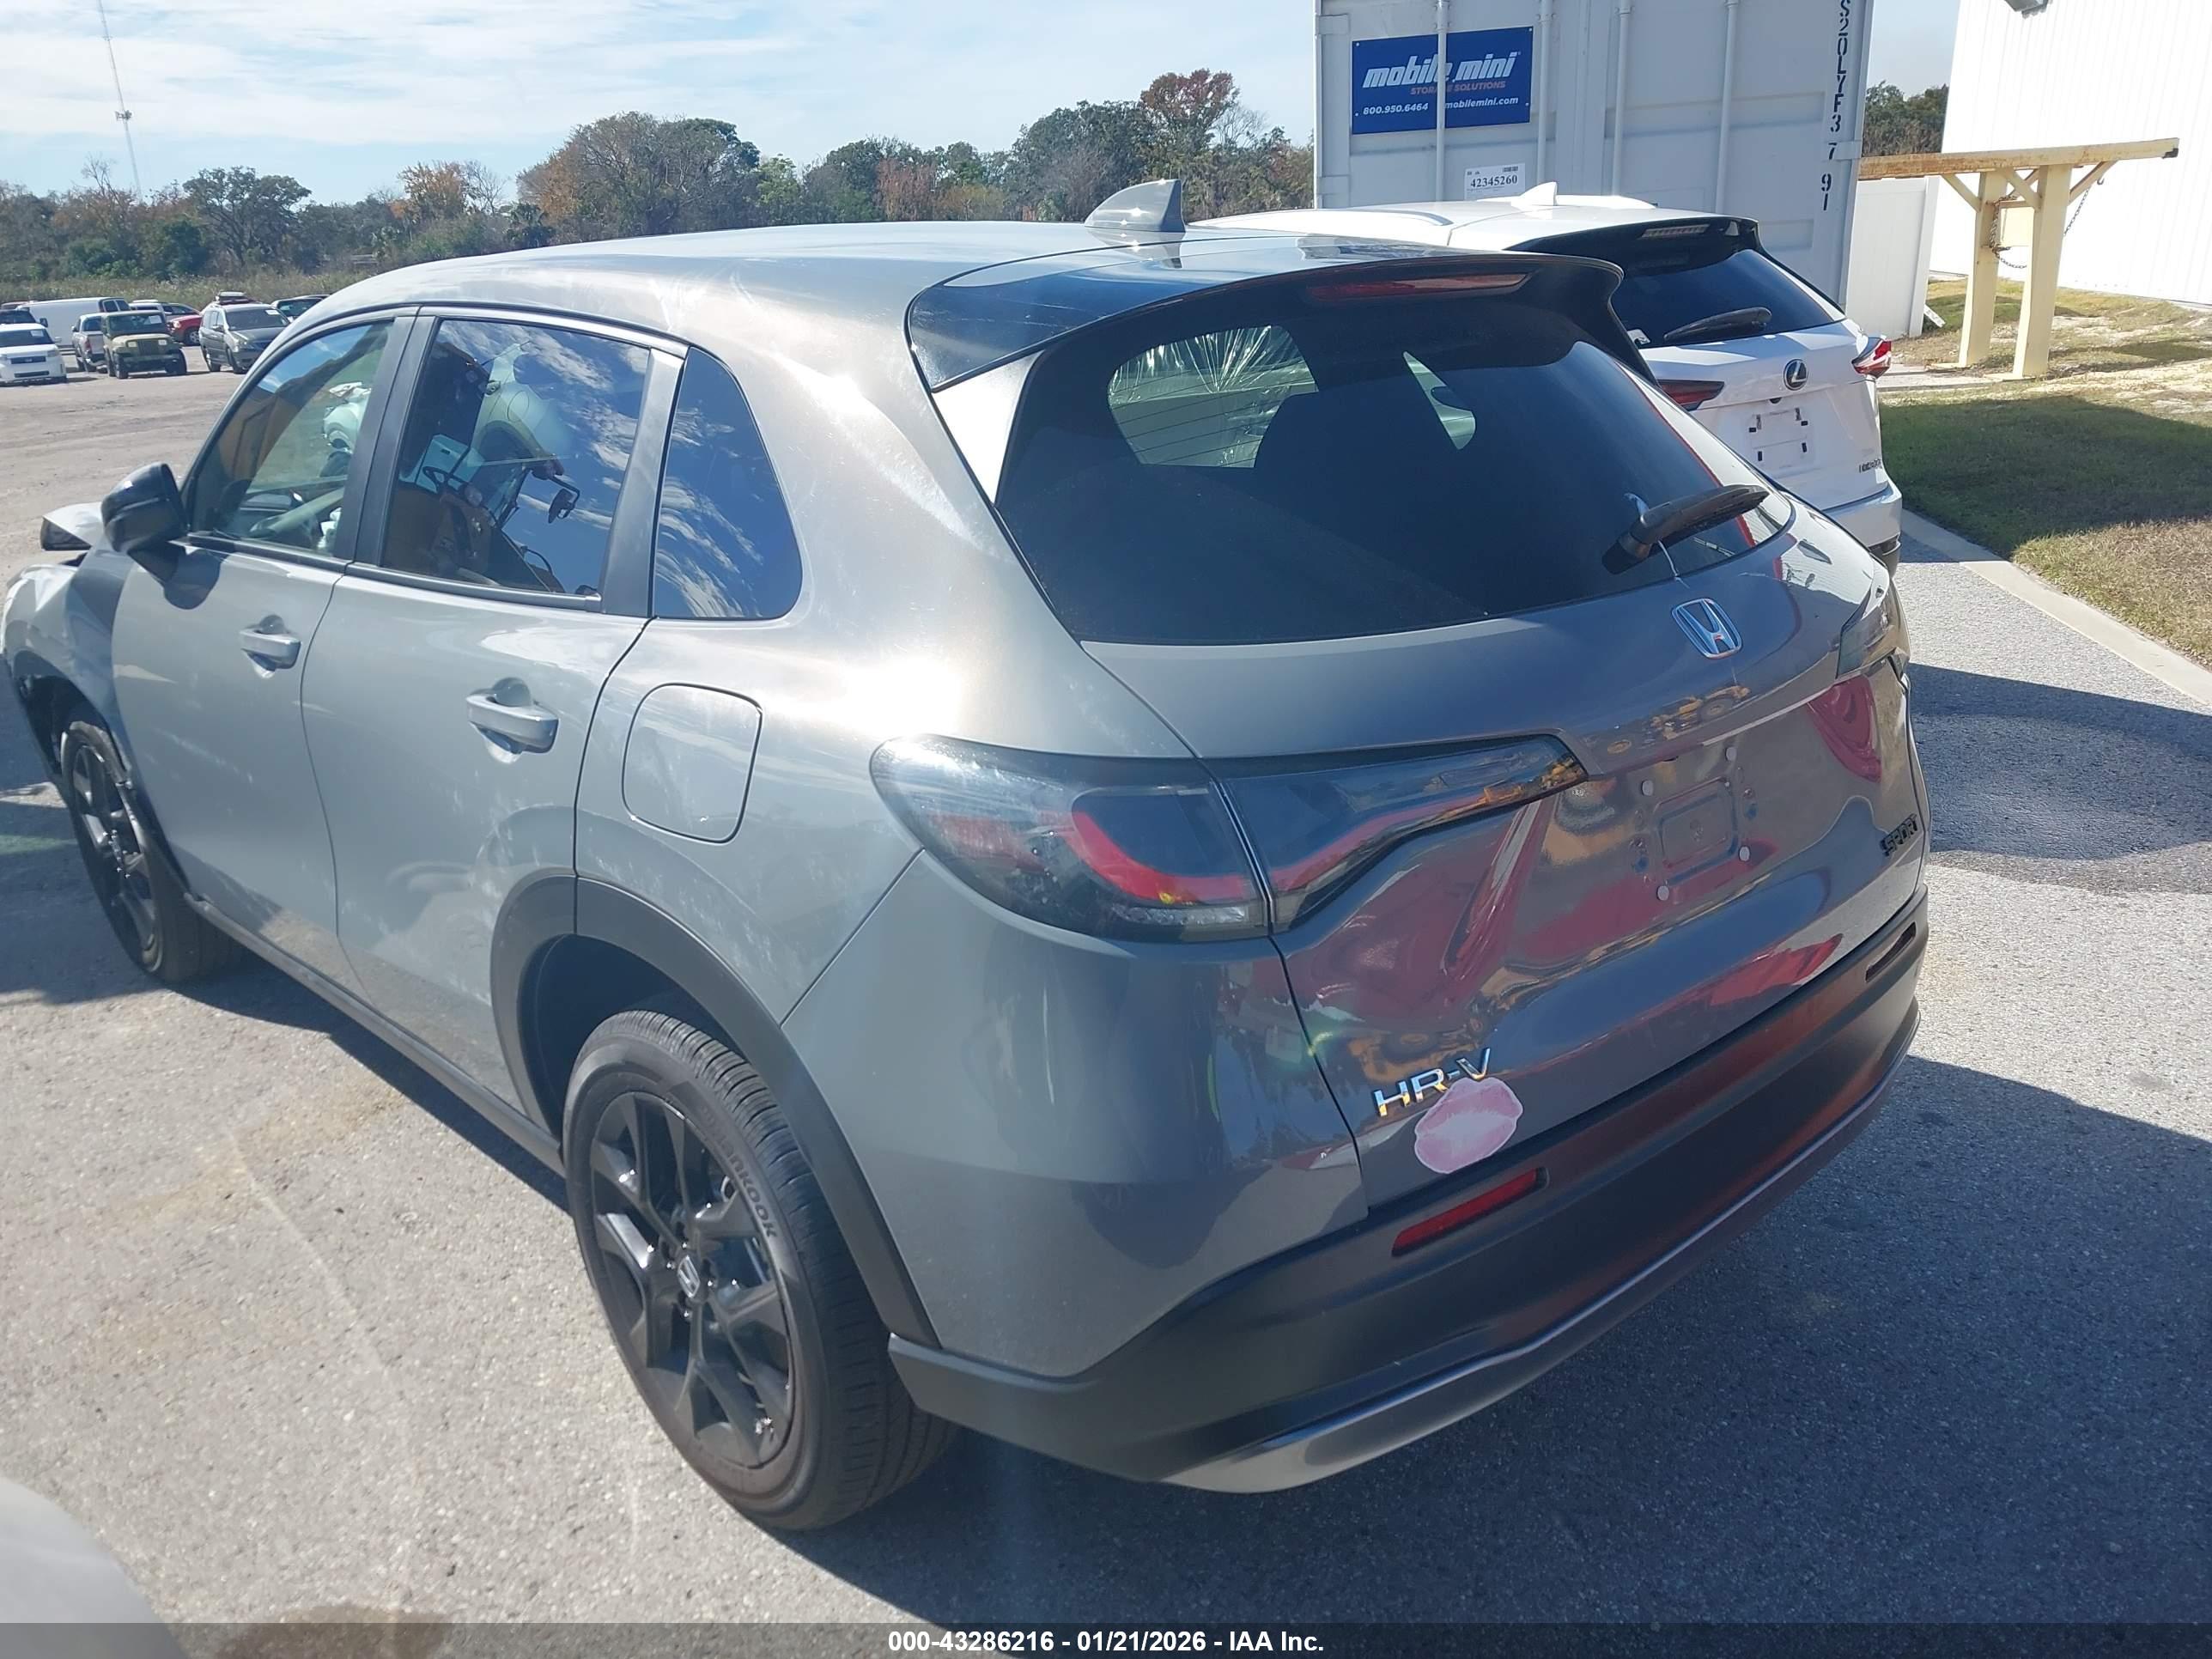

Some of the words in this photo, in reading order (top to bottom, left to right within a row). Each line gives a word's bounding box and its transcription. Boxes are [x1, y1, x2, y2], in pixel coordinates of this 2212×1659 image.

[1362, 53, 1453, 88] mobile
[1454, 52, 1518, 82] mini
[1454, 81, 1506, 93] SOLUTIONS
[1363, 102, 1429, 115] 800.950.6464
[1444, 97, 1519, 110] mobilemini.com
[1470, 174, 1518, 187] 42345260
[1373, 1048, 1491, 1117] HR-V
